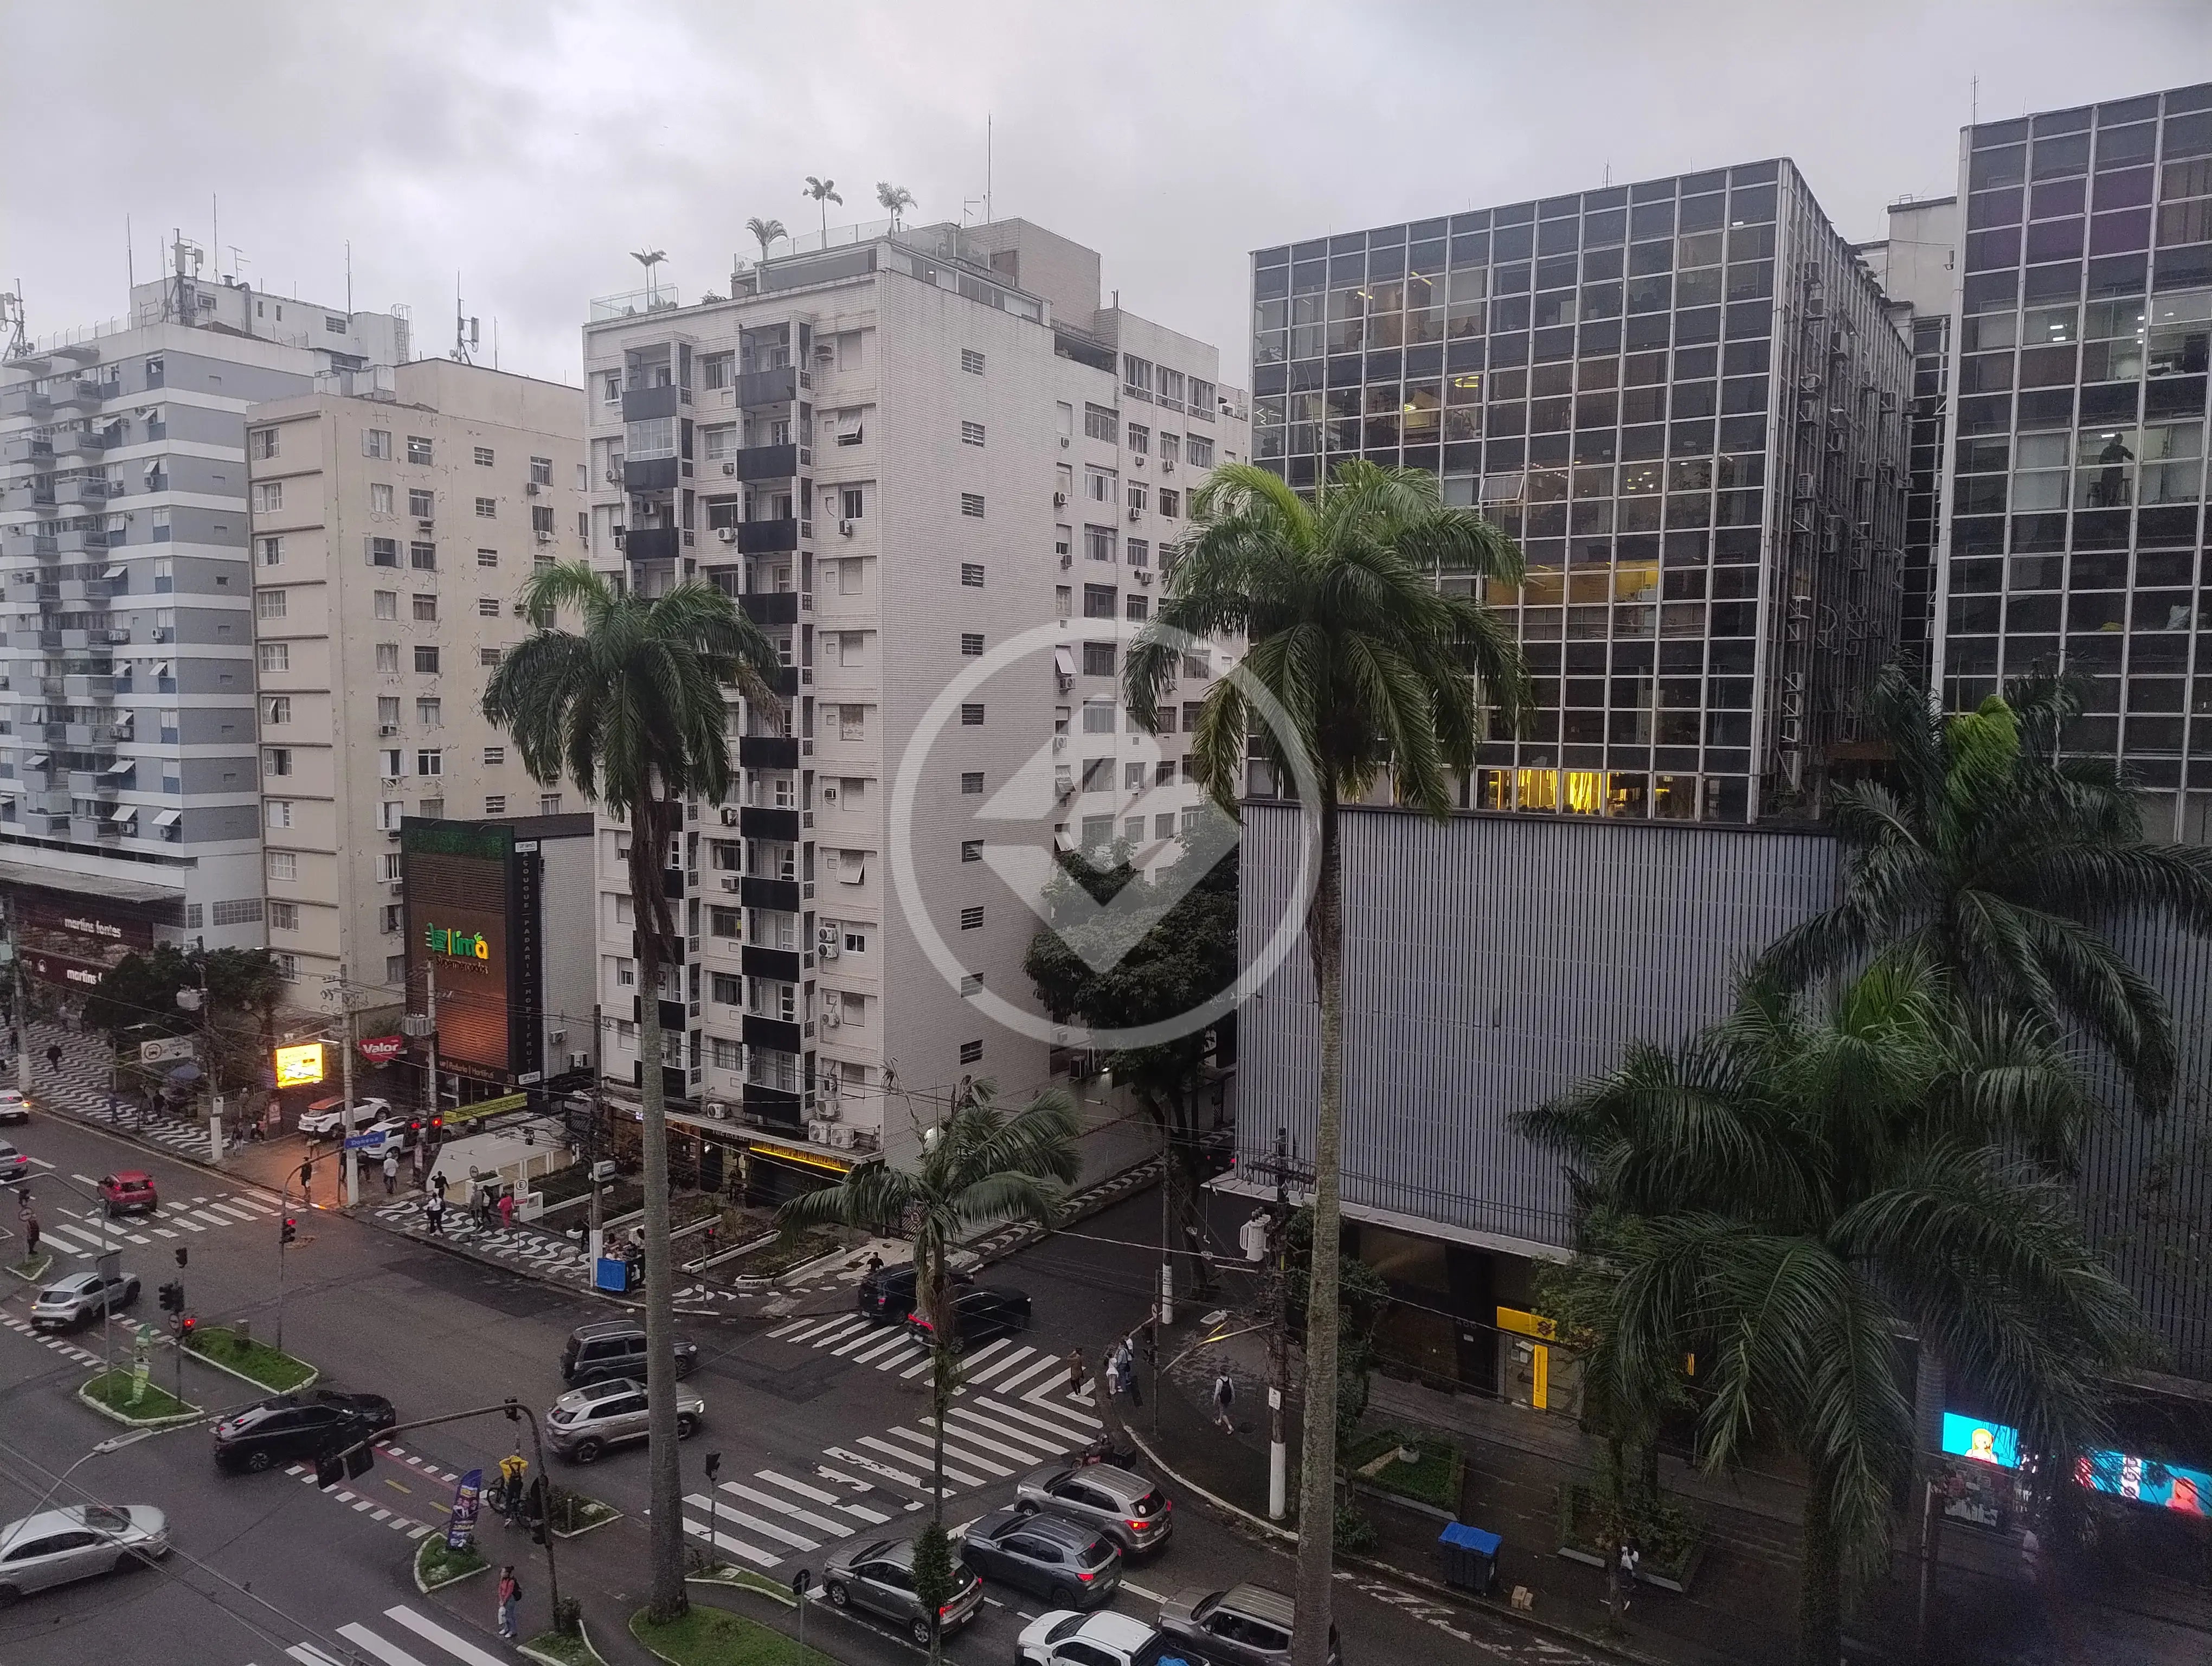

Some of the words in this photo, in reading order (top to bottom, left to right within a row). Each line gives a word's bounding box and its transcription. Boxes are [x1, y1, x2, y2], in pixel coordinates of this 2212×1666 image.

[522, 852, 530, 908] AÇOUGUE
[65, 918, 95, 933] martins
[96, 920, 121, 938] fontes
[67, 969, 97, 985] martins
[362, 1042, 399, 1054] Valor
[774, 1144, 796, 1157] CHOPP
[798, 1150, 807, 1159] DO
[809, 1153, 841, 1168] GONZAGA
